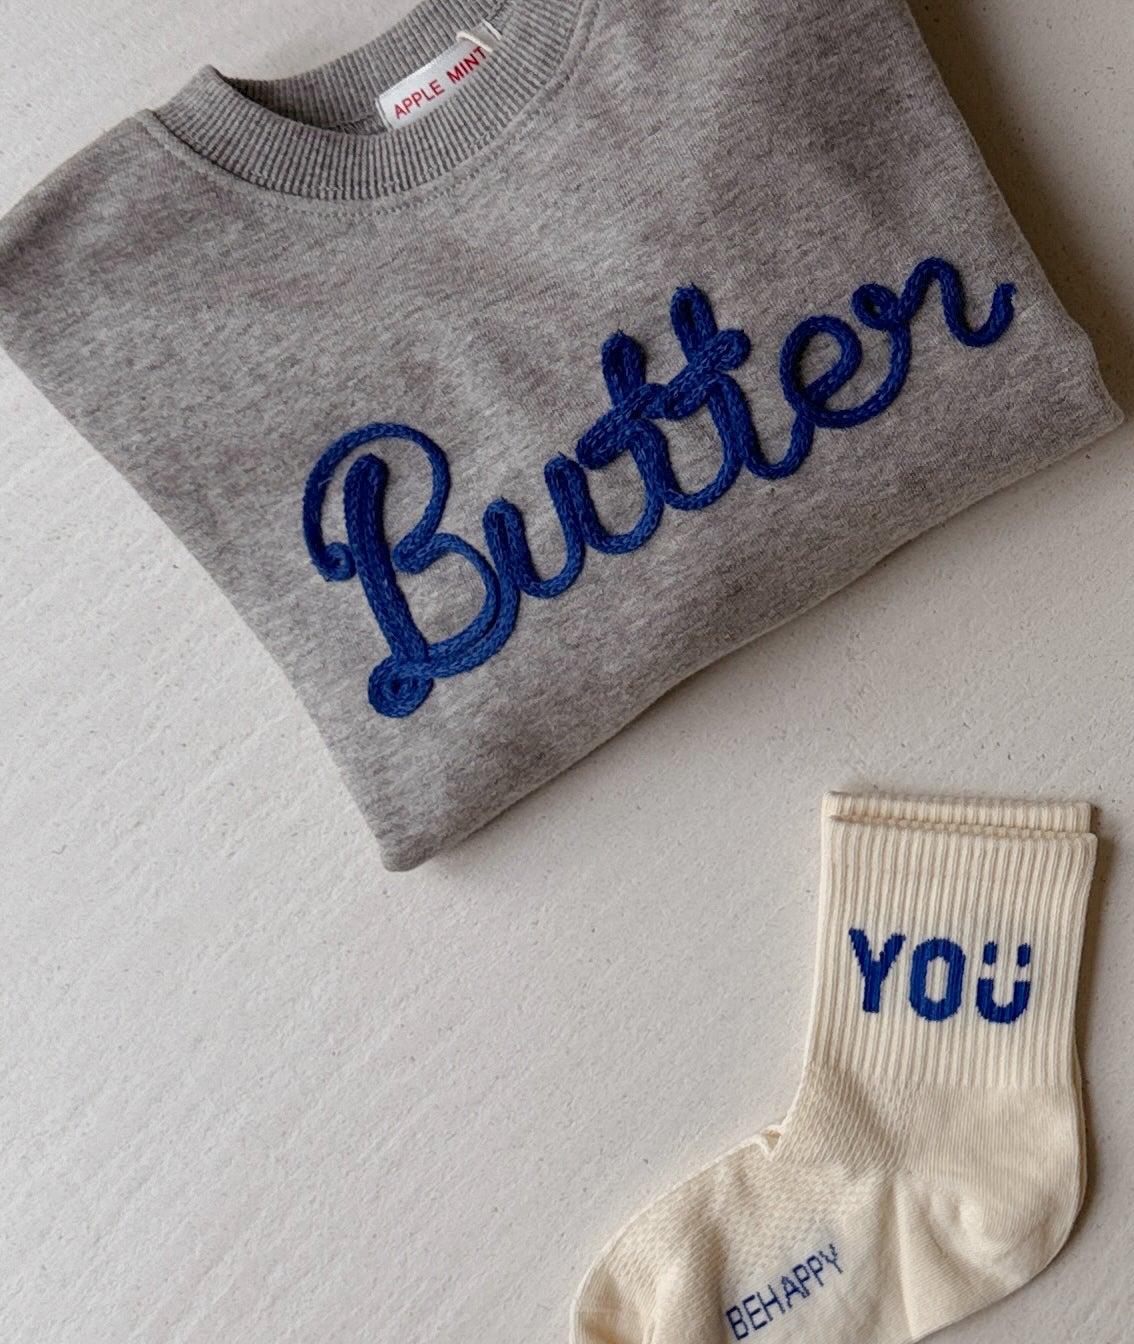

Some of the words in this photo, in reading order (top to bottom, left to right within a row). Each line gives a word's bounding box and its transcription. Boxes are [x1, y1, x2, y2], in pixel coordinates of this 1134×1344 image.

[393, 79, 445, 119] APPLE
[446, 45, 488, 84] MINT
[301, 256, 1017, 719] Butter
